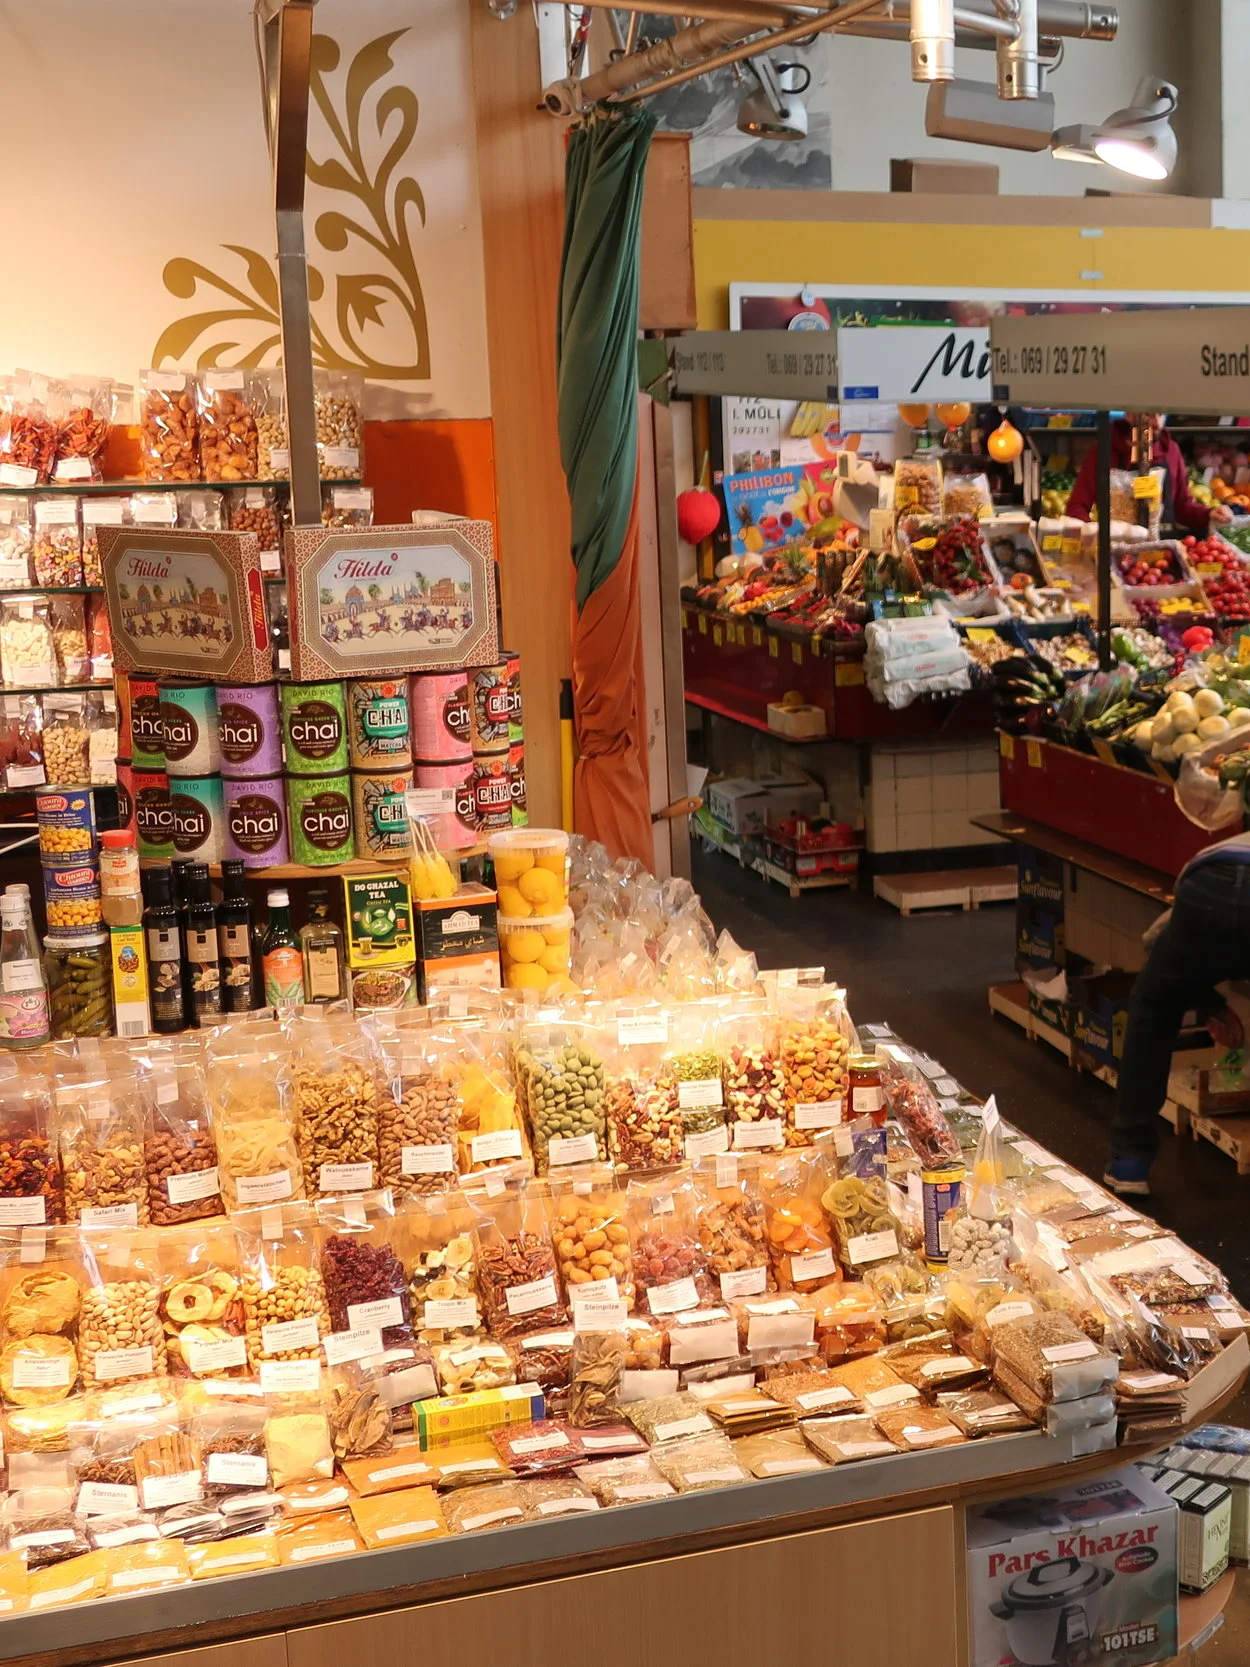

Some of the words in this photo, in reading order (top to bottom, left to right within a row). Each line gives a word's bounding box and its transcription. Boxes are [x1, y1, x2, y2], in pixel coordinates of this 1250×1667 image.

[803, 353, 813, 375] 29
[814, 353, 825, 375] 27
[826, 353, 837, 376] 31
[1021, 347, 1042, 374] 069
[1053, 347, 1068, 374] 29
[1072, 347, 1087, 374] 27
[1091, 347, 1106, 374] 31
[1201, 344, 1249, 377] Stand
[744, 407, 781, 420] MÜL
[730, 472, 794, 493] PHILIBON
[366, 708, 407, 728] CHAI
[163, 722, 192, 742] hai
[291, 719, 339, 741] chai
[477, 782, 511, 805] CHA
[173, 813, 204, 833] hai
[231, 813, 279, 834] chai
[304, 810, 349, 832] chai
[354, 883, 366, 892] DO
[366, 880, 400, 890] GHAZAL
[368, 891, 386, 899] TEA
[444, 921, 467, 929] AHMAD
[359, 1303, 391, 1314] Cranberry
[584, 1303, 620, 1311] Steinpilze
[333, 1328, 370, 1343] Steinpilze
[220, 1457, 257, 1468] Sternanis
[91, 1488, 128, 1499] Sternanis
[988, 1549, 1051, 1578] Pars
[1057, 1525, 1159, 1558] Khazar
